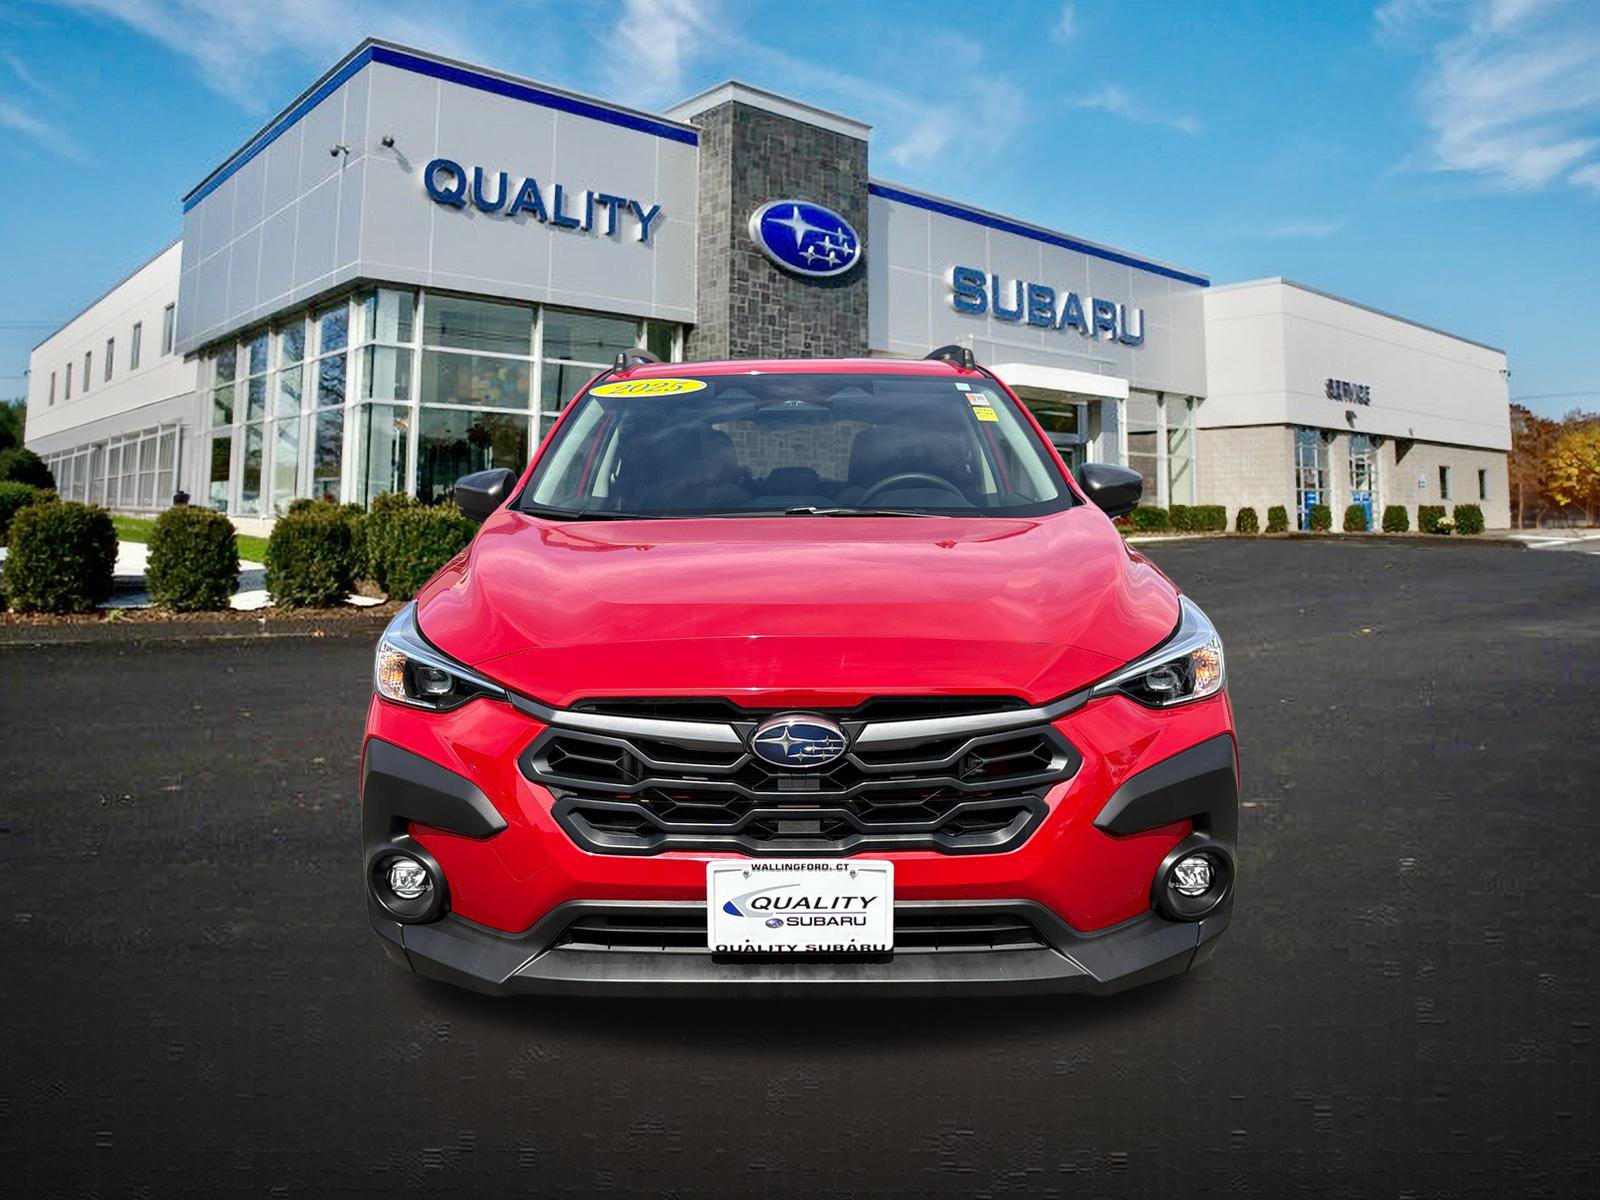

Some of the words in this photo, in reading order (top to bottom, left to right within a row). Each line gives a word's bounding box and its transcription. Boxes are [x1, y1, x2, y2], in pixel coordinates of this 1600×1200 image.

[424, 158, 661, 242] QUALITY
[952, 265, 1145, 346] SUBARU
[609, 382, 688, 394] 2025
[835, 863, 849, 871] CT
[750, 896, 878, 910] QUALITY
[786, 916, 867, 926] SUBARU
[715, 944, 797, 952] QUALITY
[805, 944, 886, 952] SUBARU
